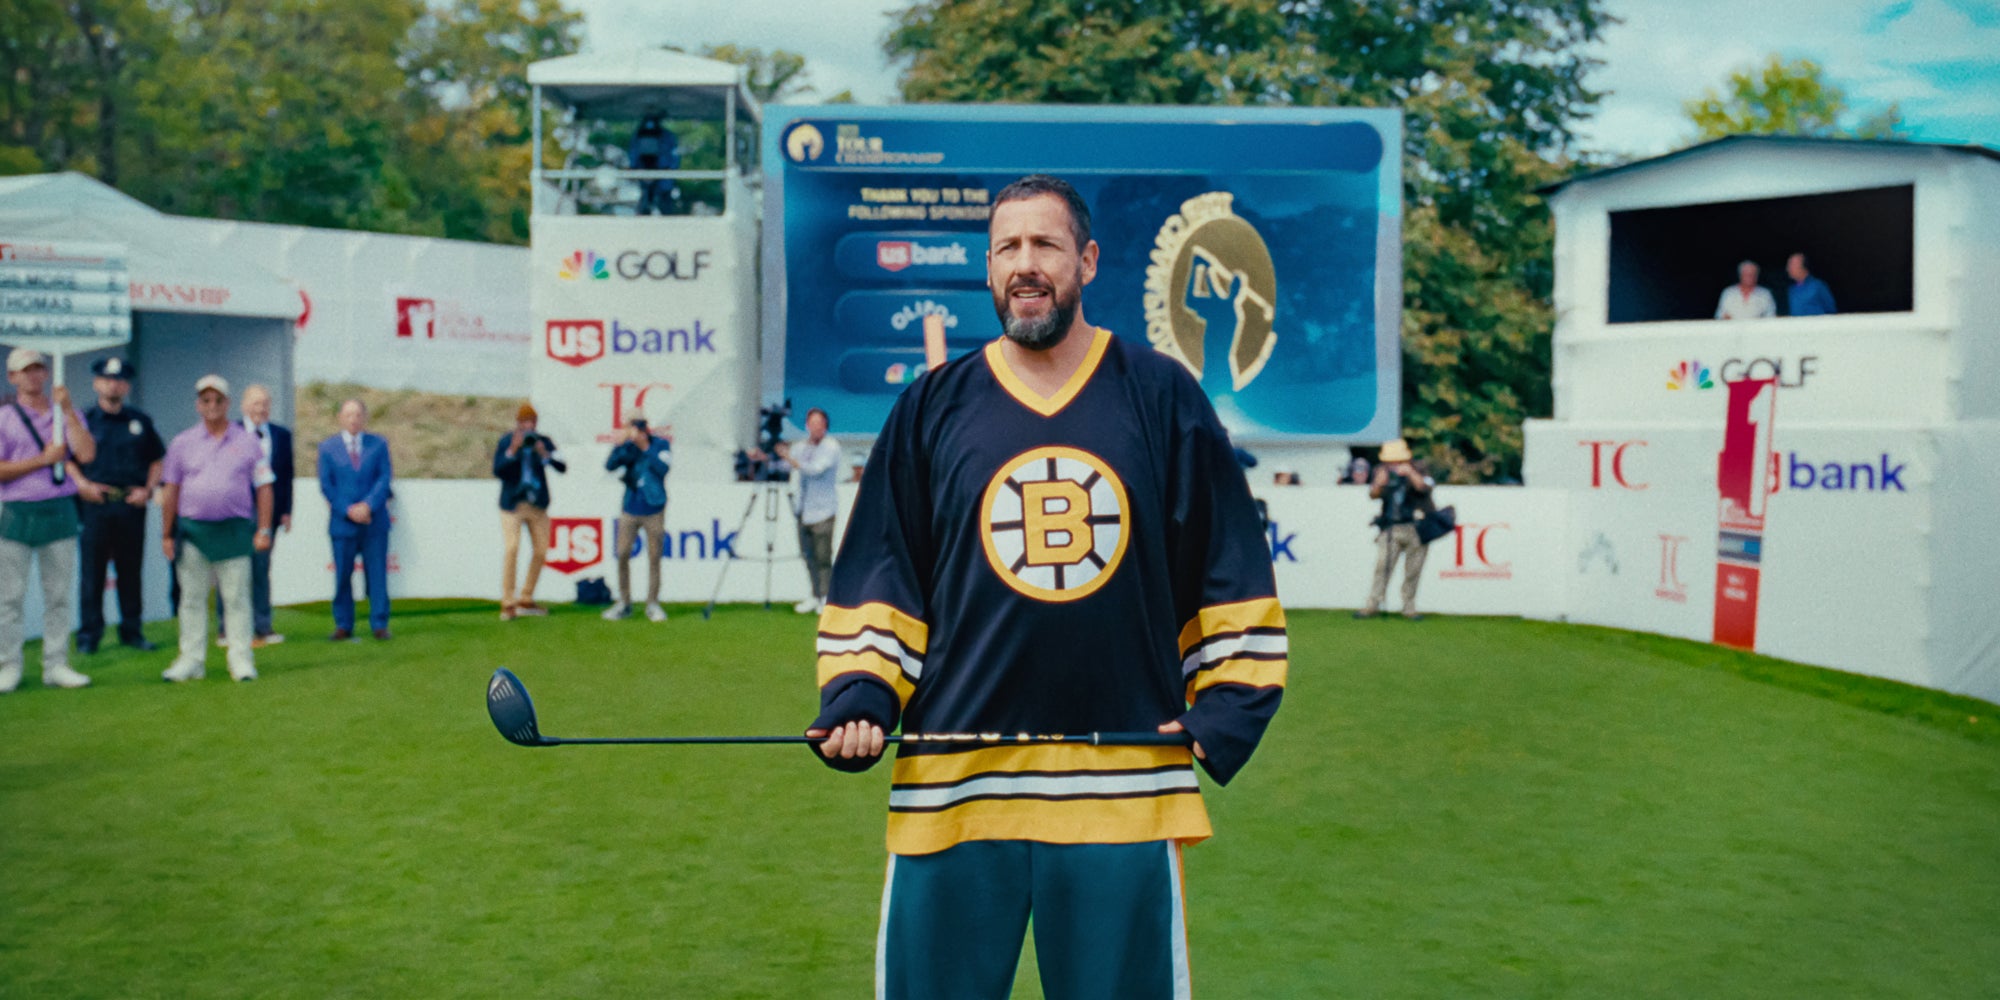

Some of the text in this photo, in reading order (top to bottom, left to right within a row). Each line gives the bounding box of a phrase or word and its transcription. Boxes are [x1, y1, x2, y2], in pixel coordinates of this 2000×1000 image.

[848, 205, 927, 219] FOLLOWING
[860, 187, 989, 203] THANK YOU TO THE
[616, 250, 713, 280] GOLF
[911, 241, 968, 265] bank
[548, 319, 717, 359] us bank
[1720, 356, 1818, 388] GOLF
[1578, 440, 1649, 490] TC
[1747, 384, 1774, 516] 1
[1788, 452, 1906, 492] bank
[1020, 478, 1095, 567] B
[1454, 522, 1512, 569] TC
